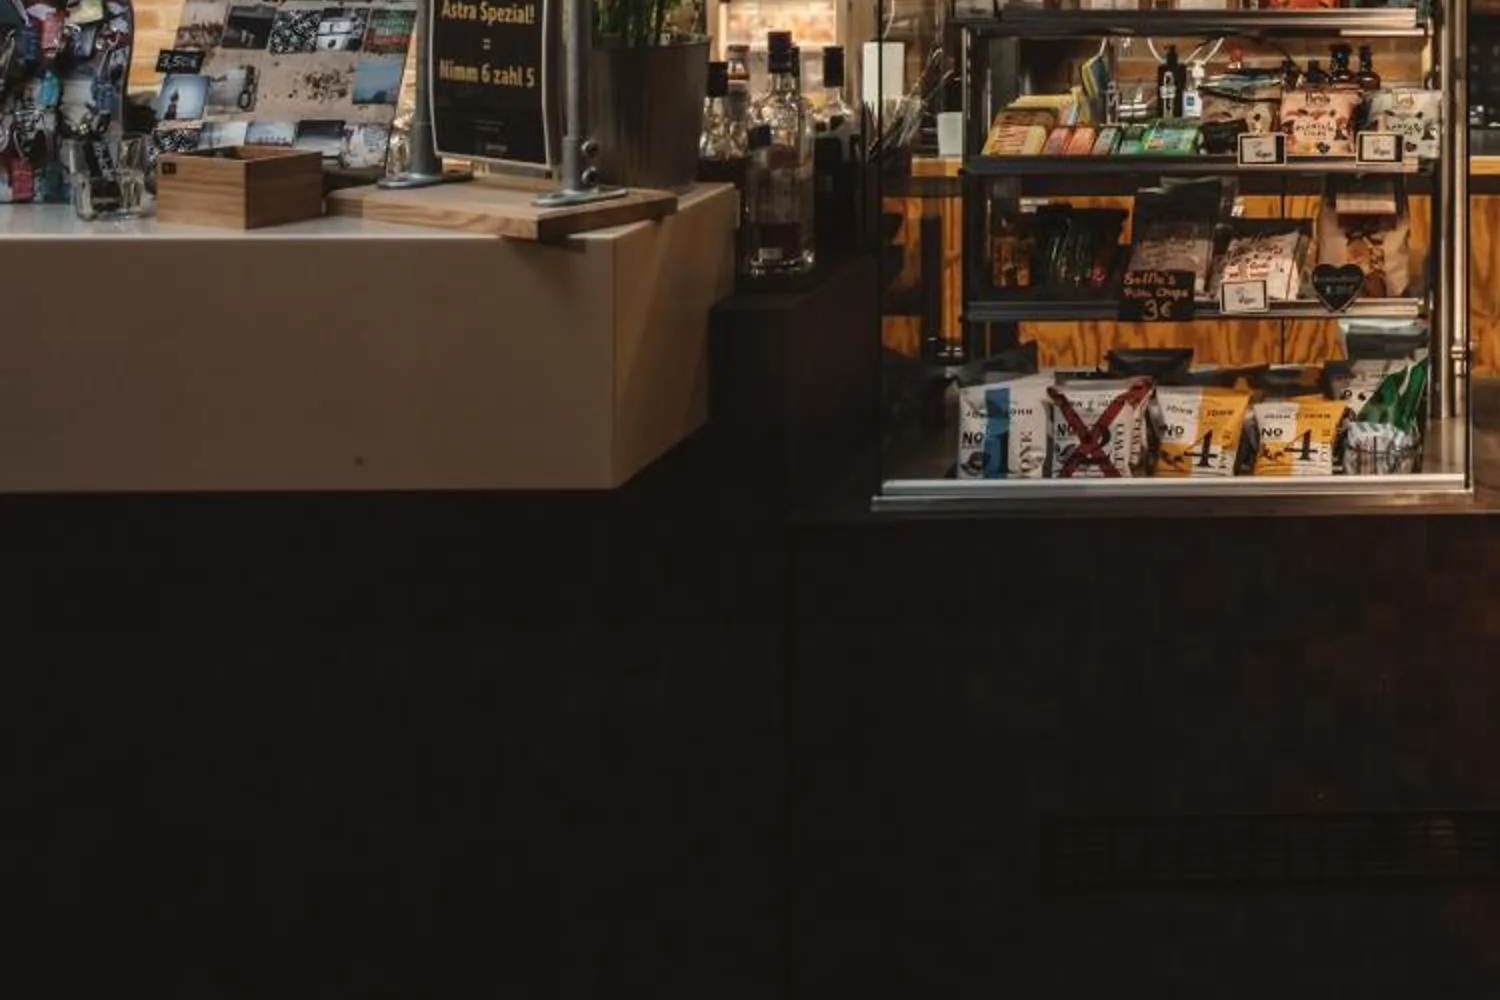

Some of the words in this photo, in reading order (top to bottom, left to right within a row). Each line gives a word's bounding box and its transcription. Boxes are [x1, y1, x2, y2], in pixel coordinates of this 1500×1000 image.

[479, 1, 535, 26] Spezial!
[439, 60, 479, 82] Nimm
[481, 63, 490, 83] 6
[493, 65, 523, 86] zahl
[526, 67, 535, 88] 5
